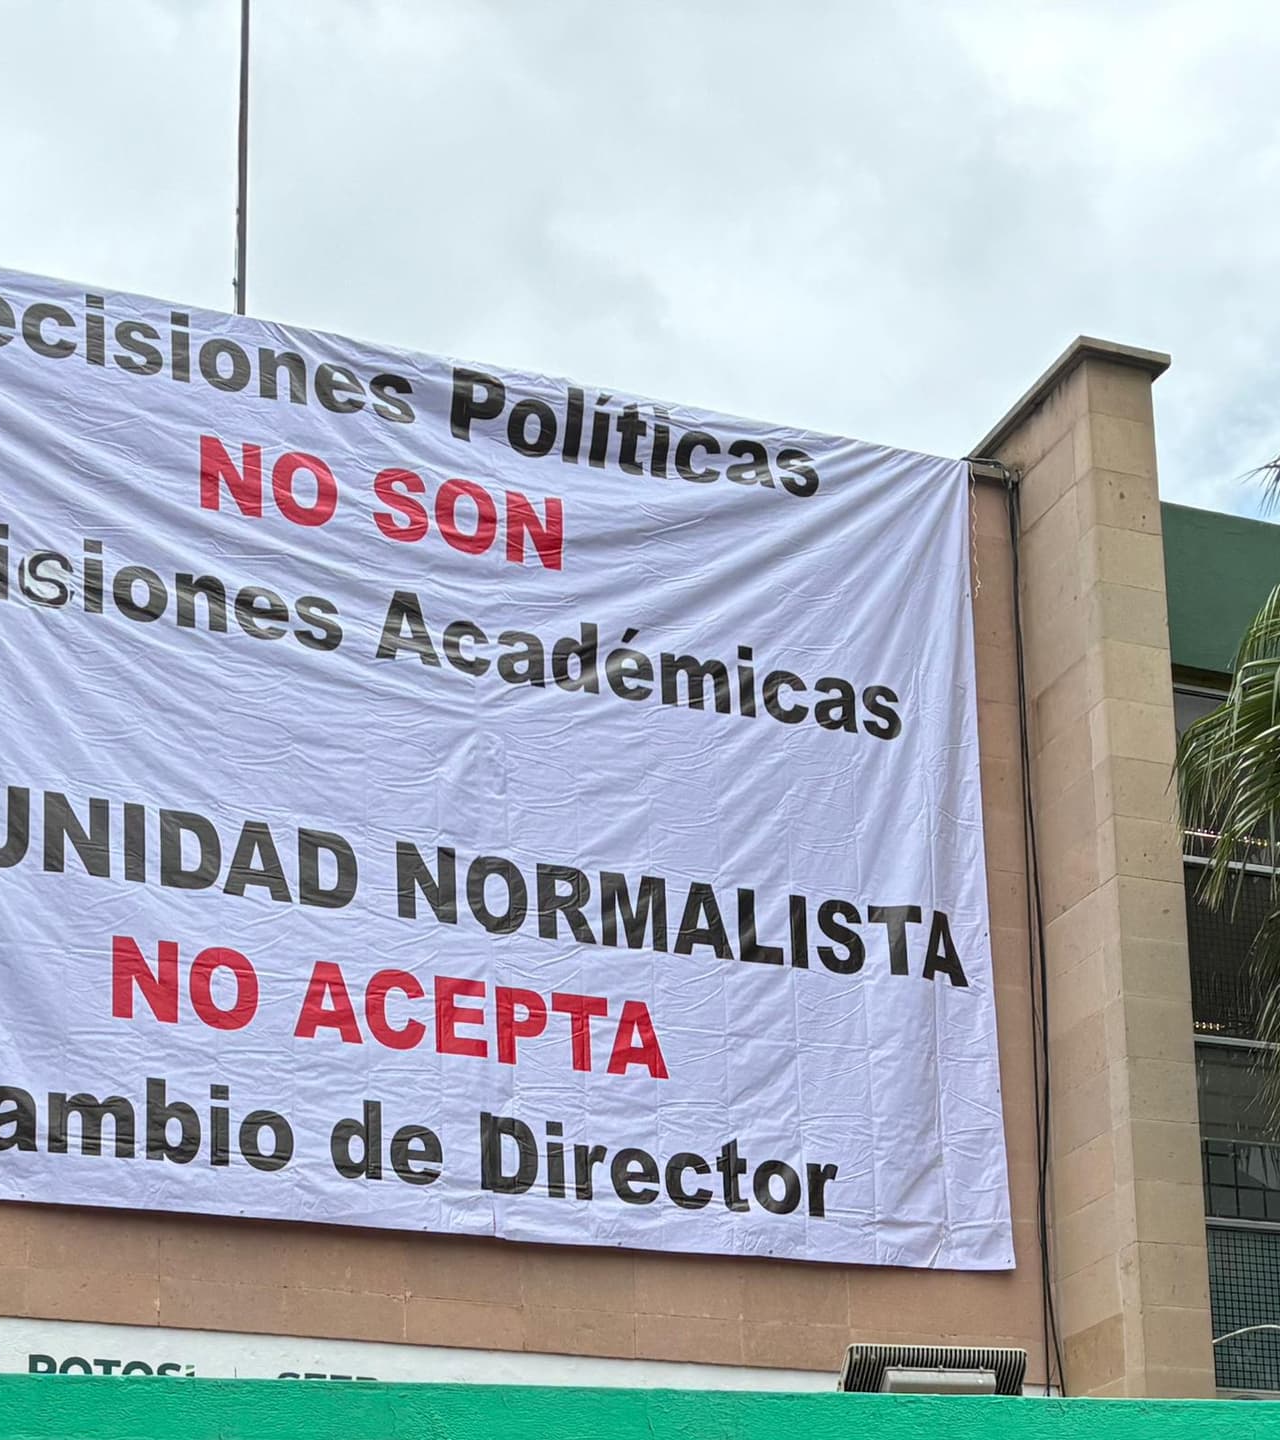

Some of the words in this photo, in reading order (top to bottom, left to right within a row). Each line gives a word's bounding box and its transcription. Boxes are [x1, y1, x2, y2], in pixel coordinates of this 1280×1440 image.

[200, 435, 338, 528] NO
[373, 468, 564, 571] SON
[448, 366, 821, 501] Políticas
[375, 591, 903, 742] Académicas
[396, 842, 969, 988] NORMALISTA
[112, 935, 260, 1031] NO
[294, 961, 669, 1080] ACEPTA
[330, 1100, 444, 1186] de
[480, 1111, 839, 1218] Director
